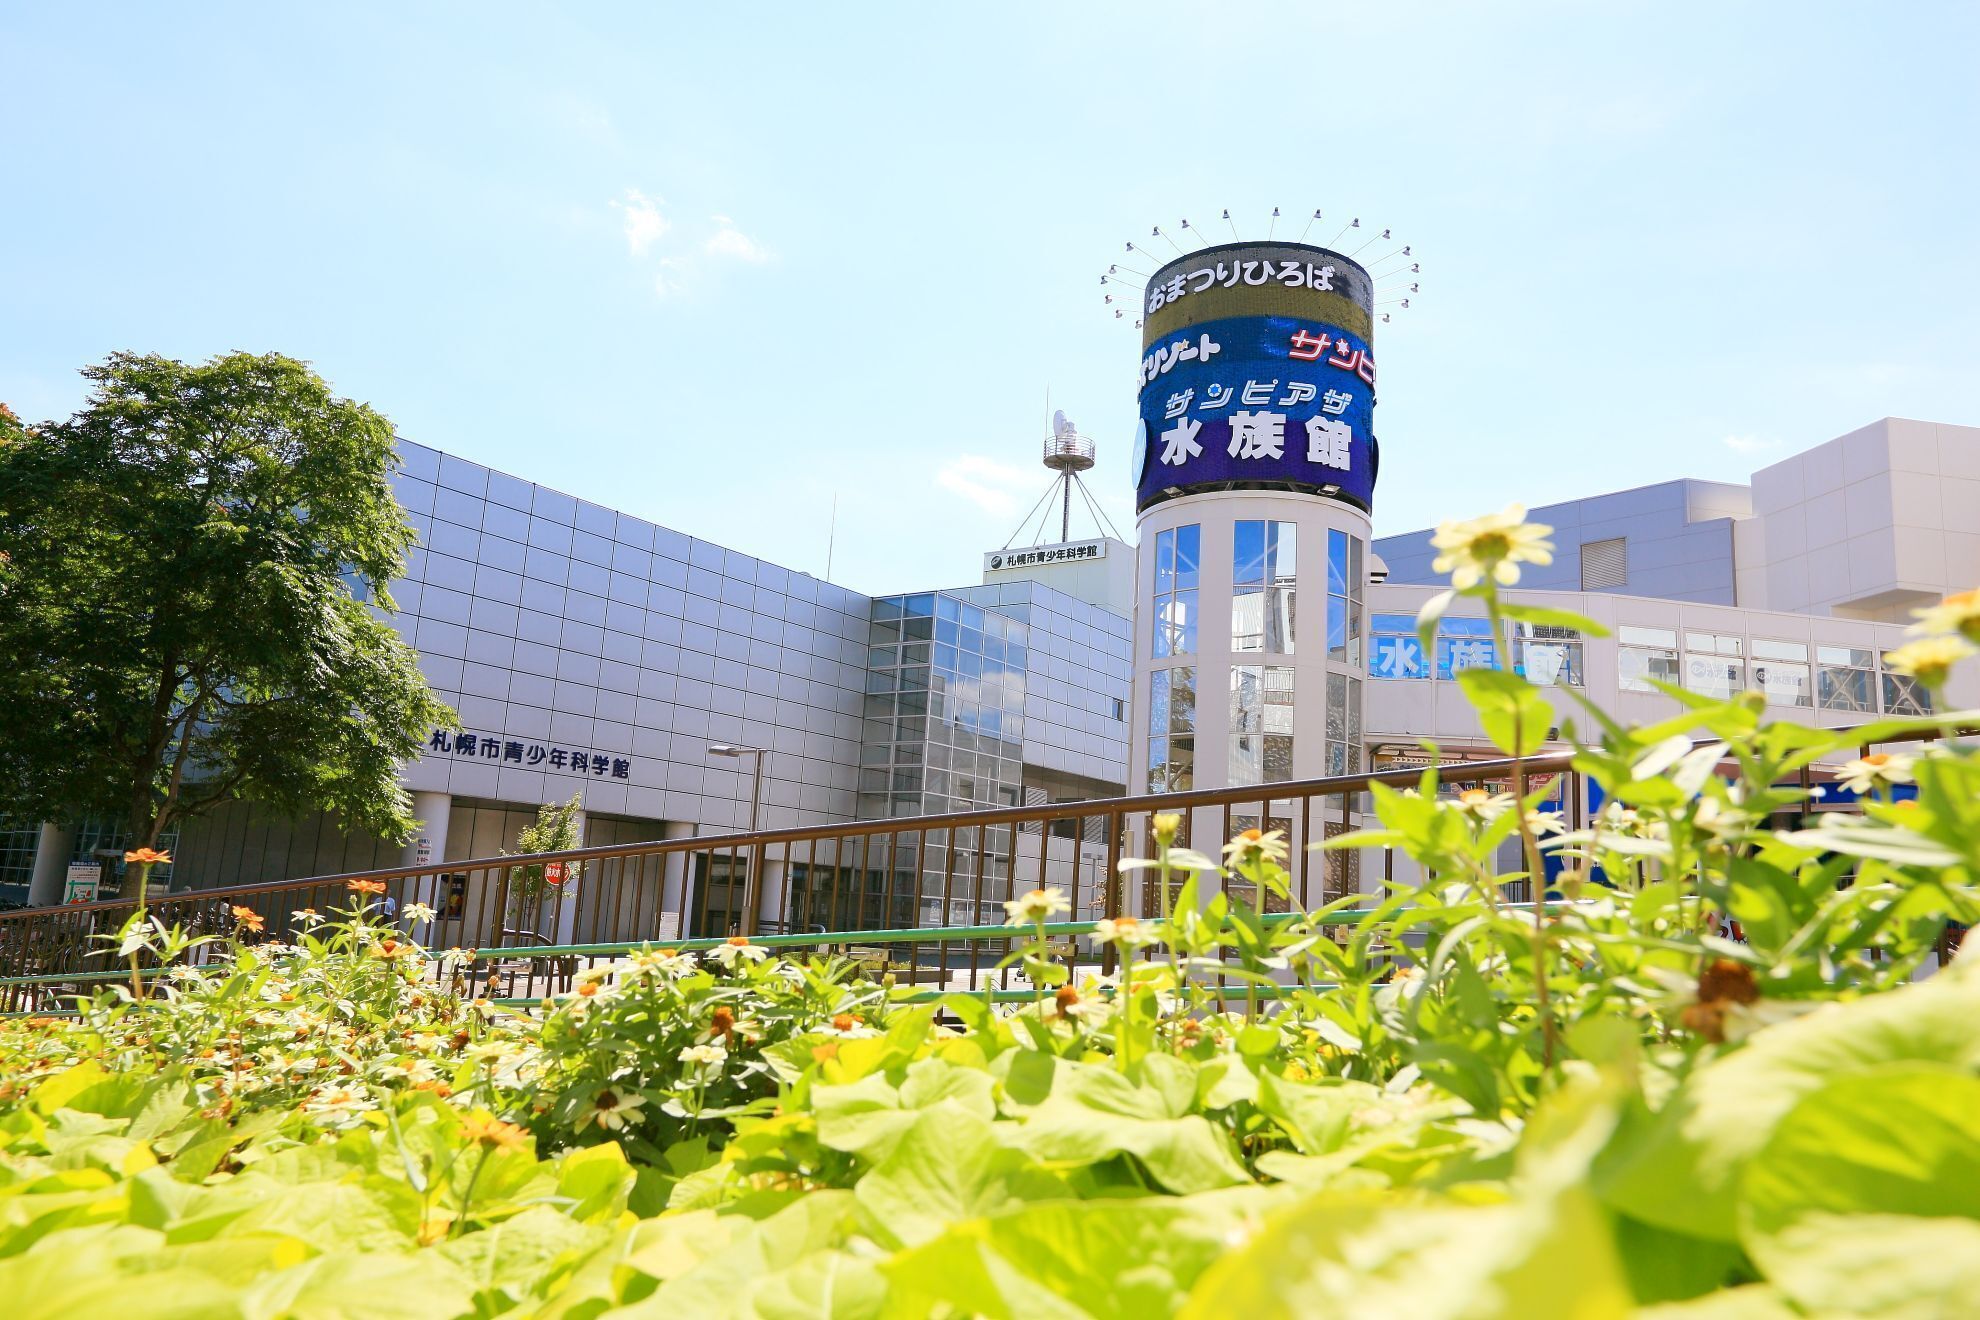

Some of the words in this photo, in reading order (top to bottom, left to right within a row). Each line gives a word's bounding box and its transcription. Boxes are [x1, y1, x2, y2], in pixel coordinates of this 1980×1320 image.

[1148, 260, 1335, 314] おまつりひろば
[1164, 379, 1353, 419] サンピアザ
[1160, 410, 1352, 471] 水族館
[1006, 544, 1098, 567] 札幌市青少年科学館
[429, 728, 630, 779] 札幌市青少年科学館
